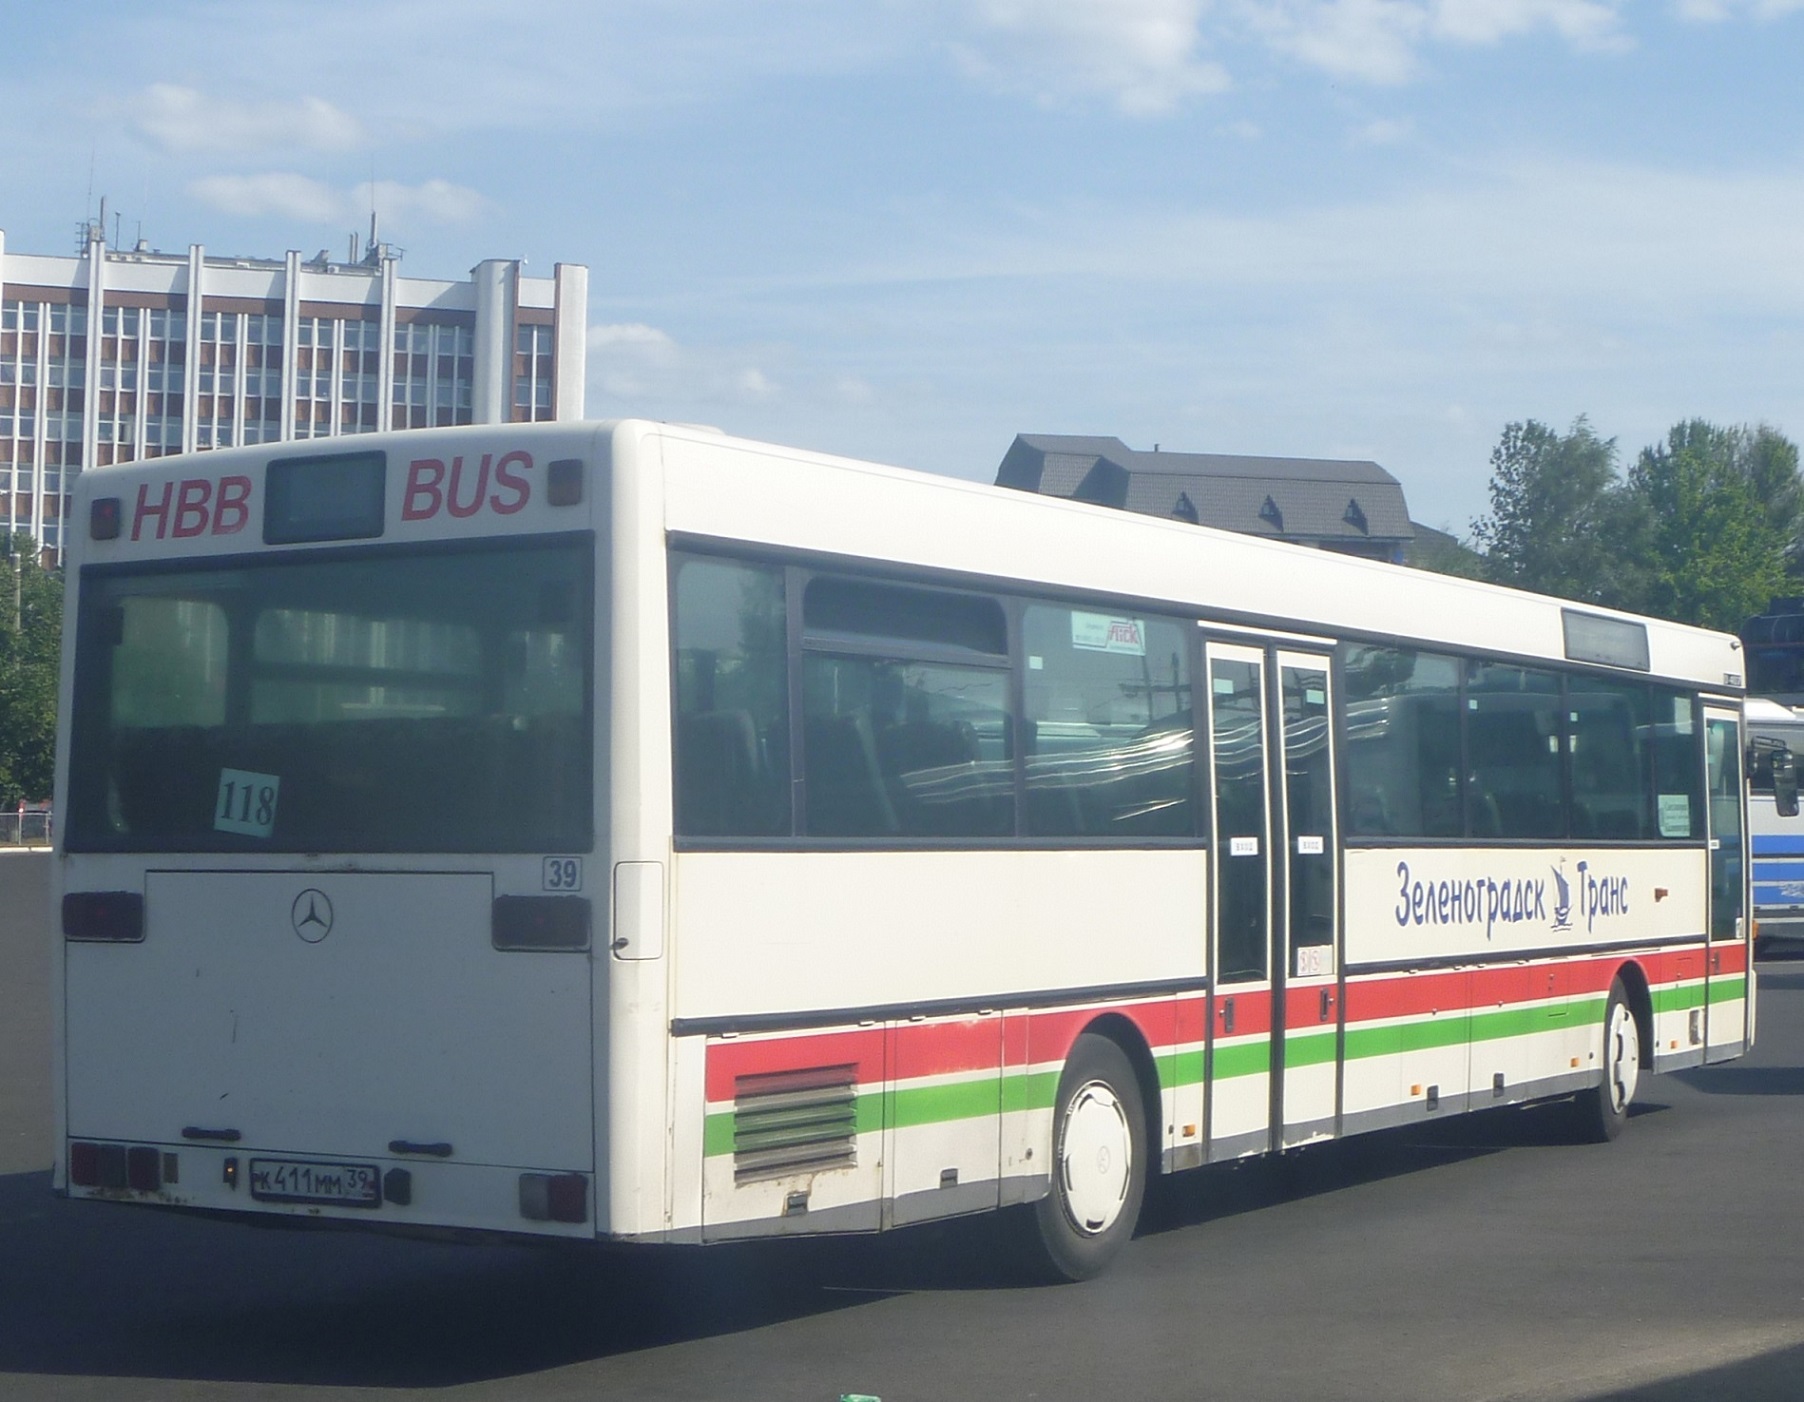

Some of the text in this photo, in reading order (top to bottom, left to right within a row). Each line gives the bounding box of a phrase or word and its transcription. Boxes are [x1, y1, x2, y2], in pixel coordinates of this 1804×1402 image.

[130, 450, 534, 541] HBB BUS
[221, 781, 275, 826] 118
[549, 860, 577, 888] 39
[1395, 860, 1628, 941] Зеленоградск Транс
